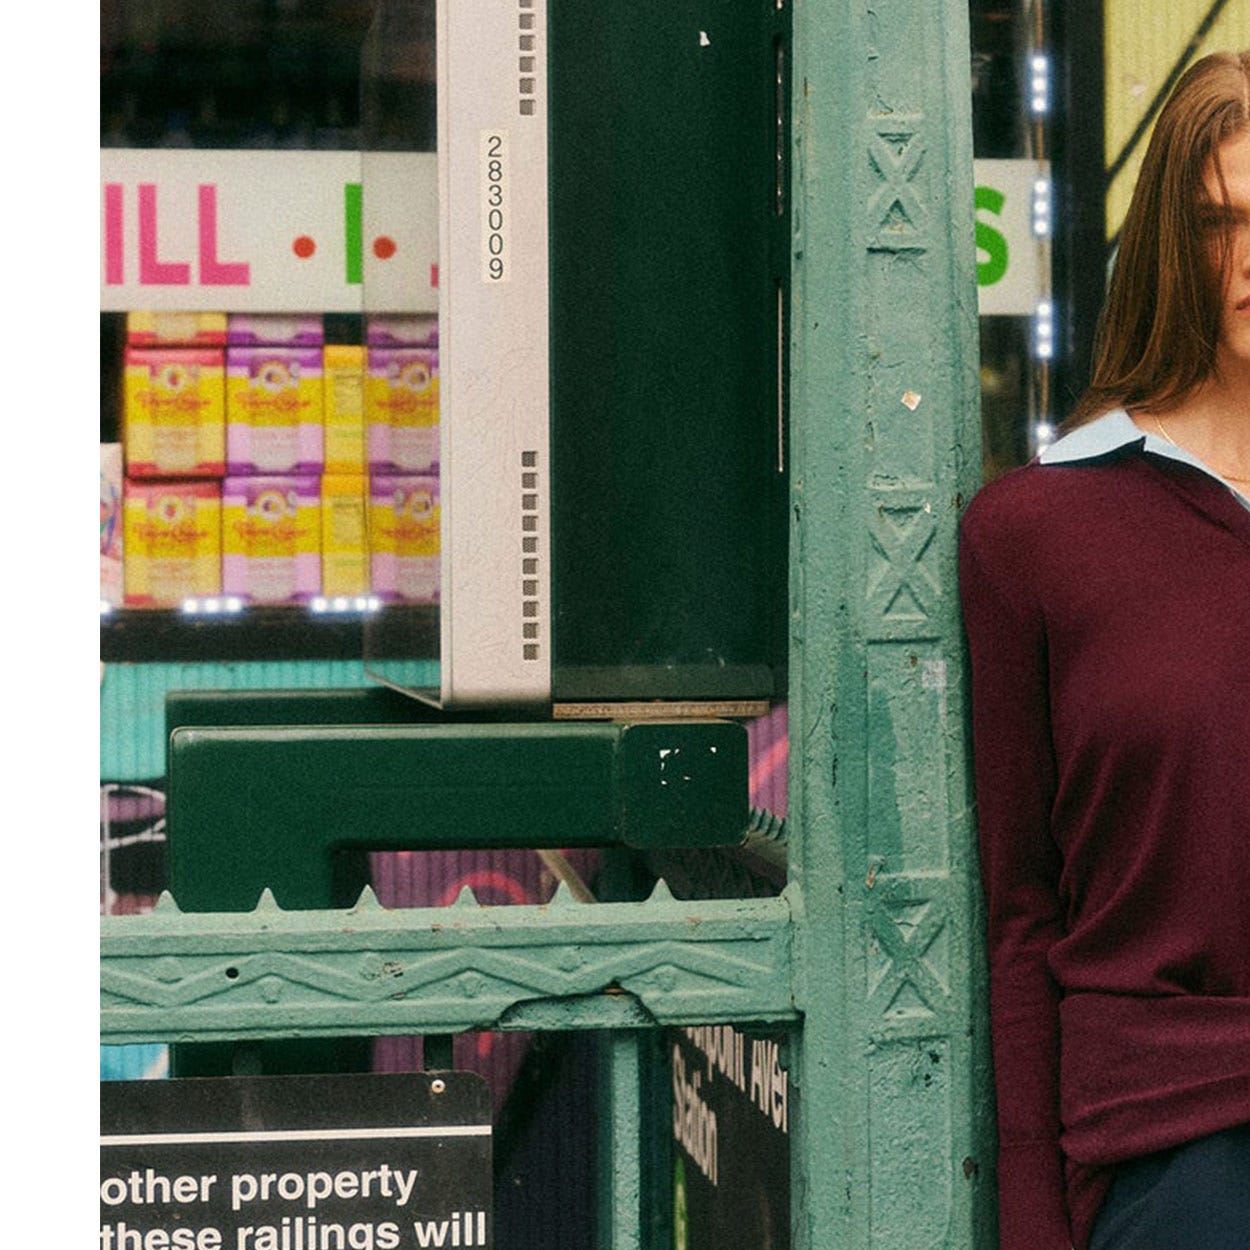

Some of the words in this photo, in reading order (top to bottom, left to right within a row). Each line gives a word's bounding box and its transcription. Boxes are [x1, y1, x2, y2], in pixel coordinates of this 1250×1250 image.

[488, 135, 504, 280] 283009
[101, 1168, 217, 1206] other
[231, 1164, 418, 1209] property
[414, 1211, 486, 1248] will
